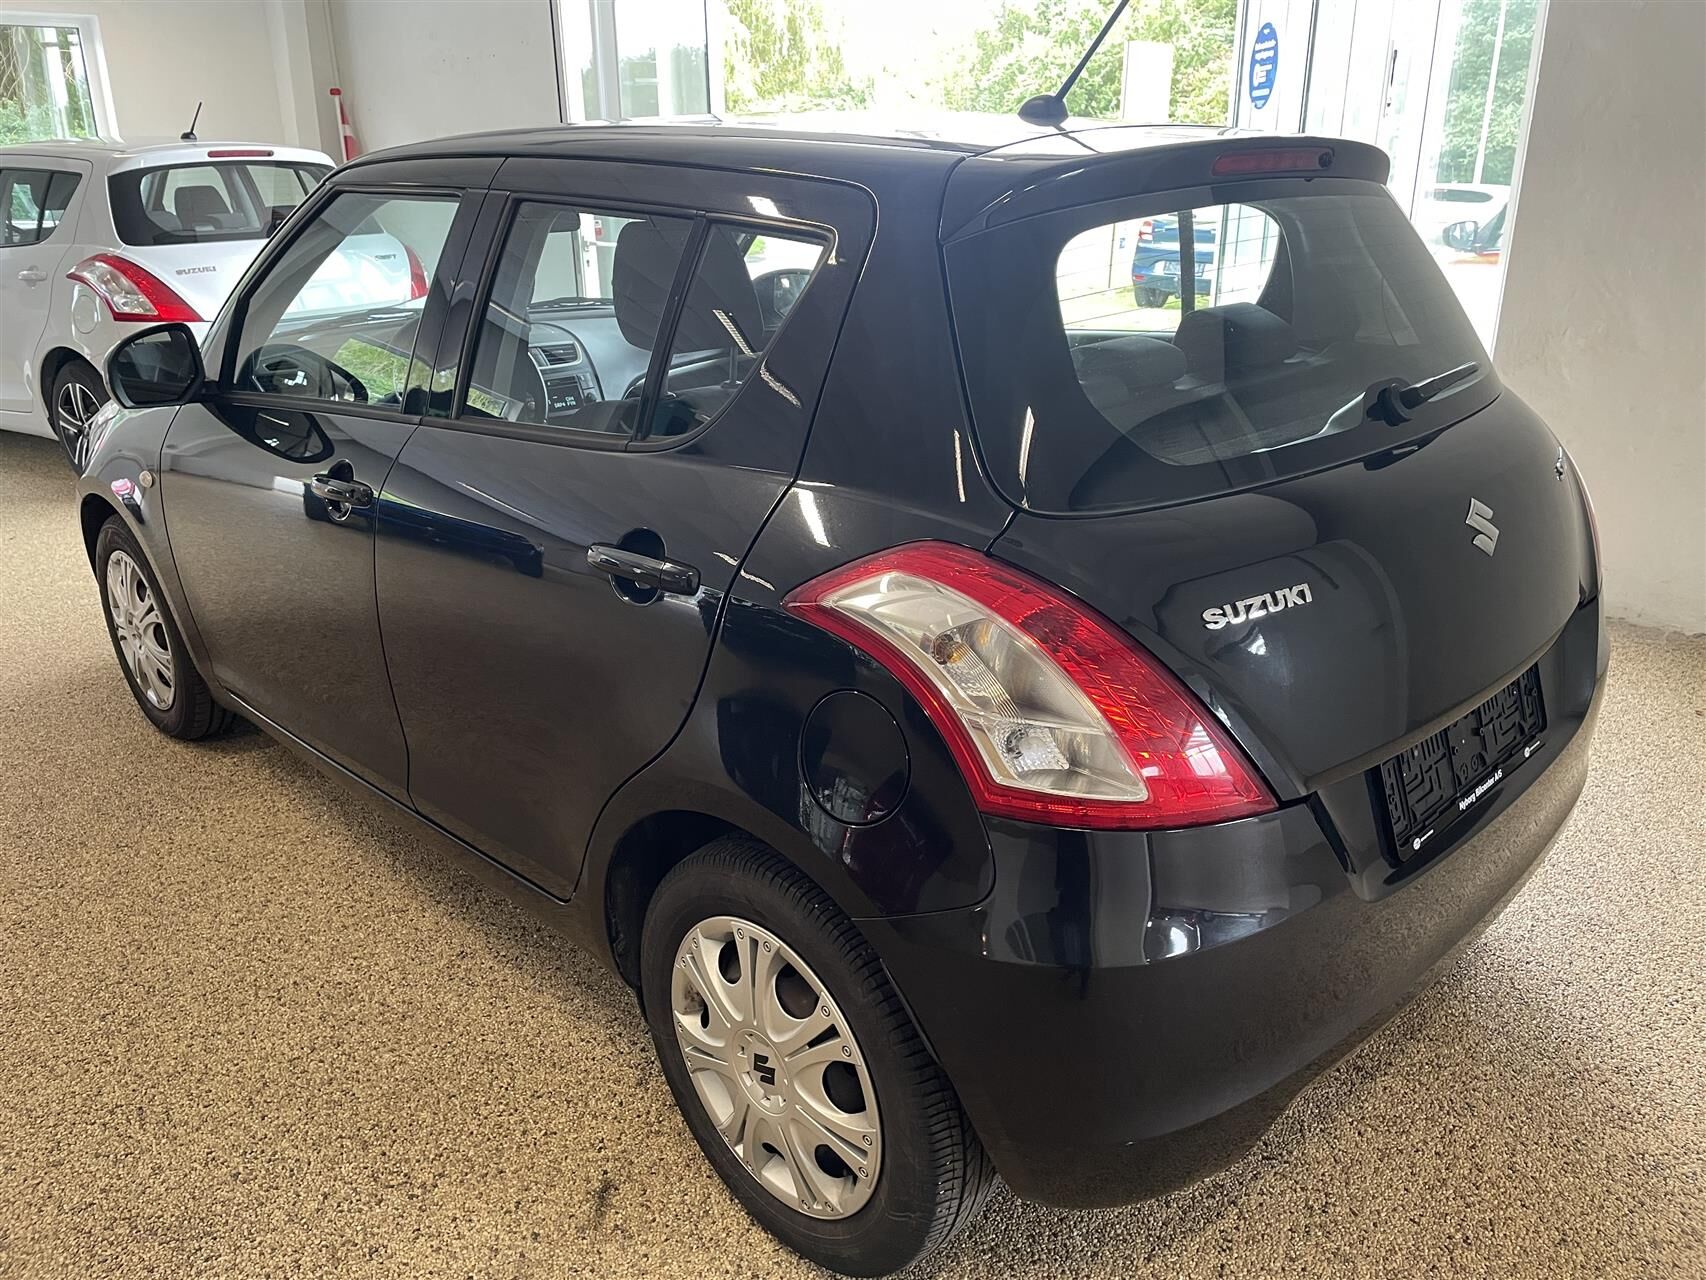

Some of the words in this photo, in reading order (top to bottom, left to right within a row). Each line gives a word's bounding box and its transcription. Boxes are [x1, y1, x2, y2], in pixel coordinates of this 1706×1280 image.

[176, 266, 216, 275] SUZUKI
[1202, 582, 1313, 630] SUZUKI
[1459, 792, 1476, 810] Nyborg
